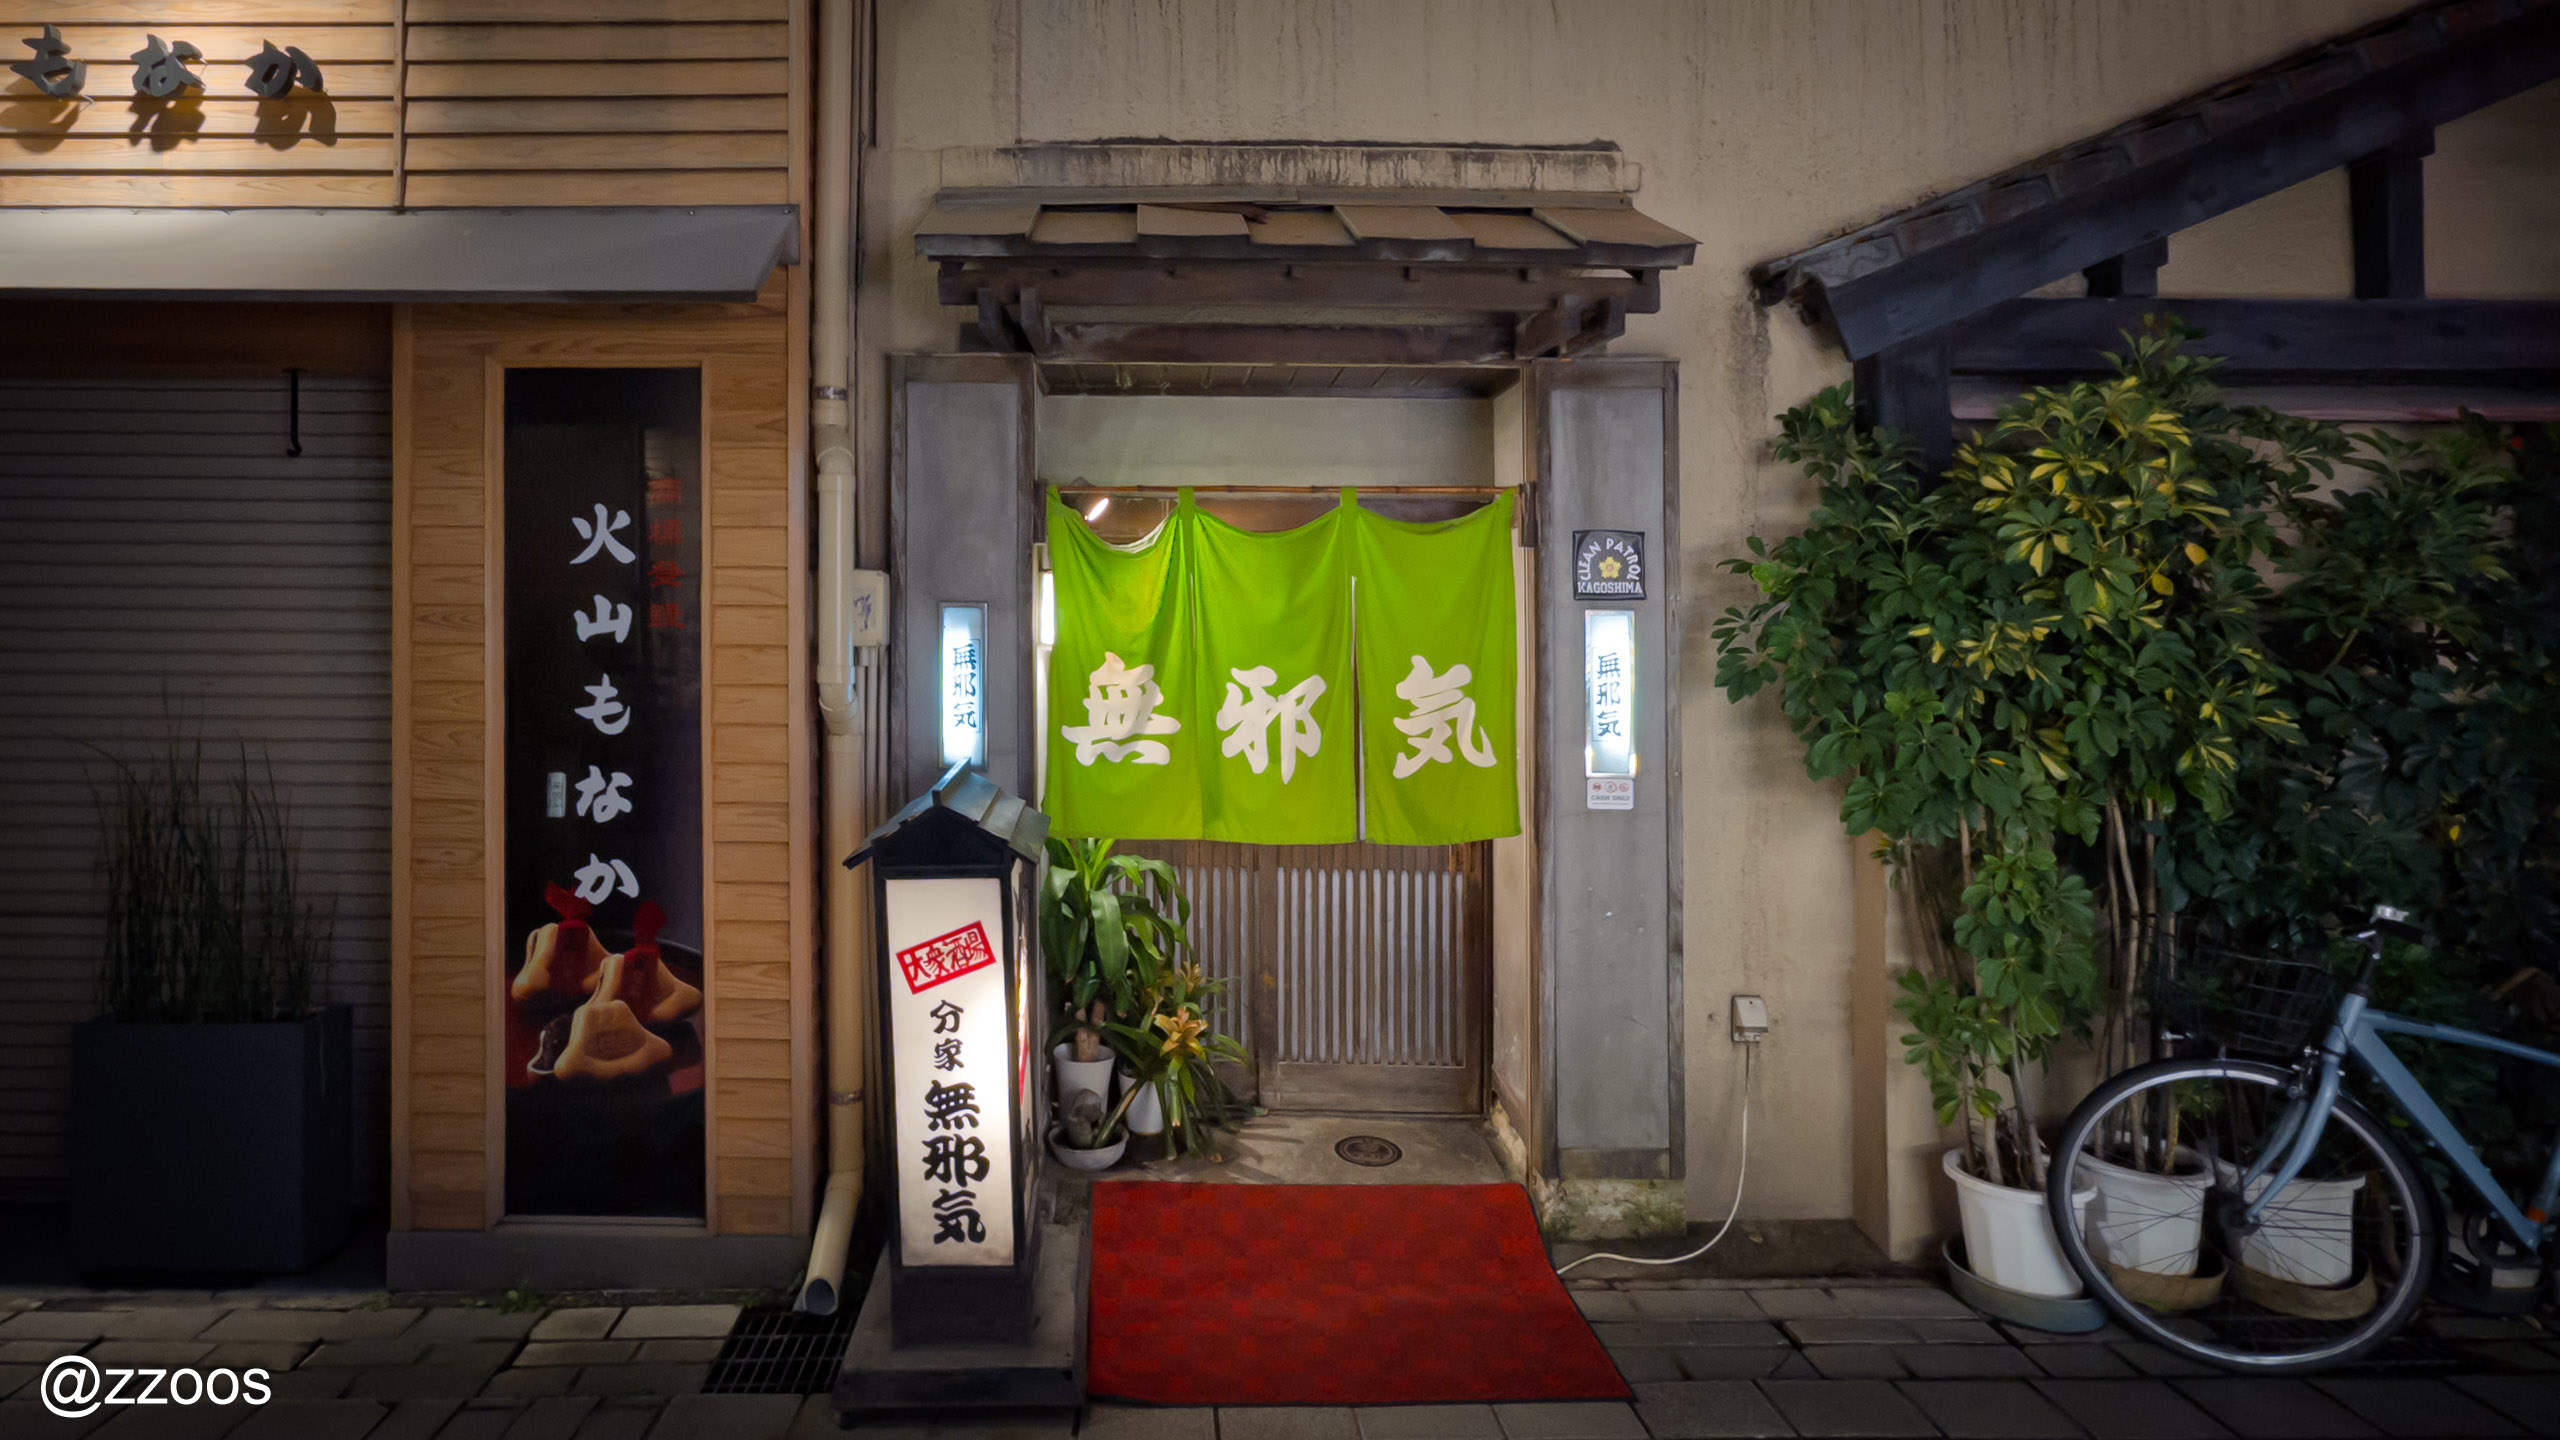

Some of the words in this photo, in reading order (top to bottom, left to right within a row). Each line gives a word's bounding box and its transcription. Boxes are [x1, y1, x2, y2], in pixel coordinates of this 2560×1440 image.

[9, 23, 325, 98] もなか
[1577, 581, 1643, 594] KAGOSHIMA
[1578, 541, 1602, 581] CLEAN
[1606, 537, 1642, 581] PATROL
[569, 503, 640, 905] 火山もなか
[952, 643, 977, 728] 無邪気
[1061, 651, 1497, 785] 無邪気
[1597, 652, 1621, 737] 無邪気
[901, 929, 989, 984] 大衆酒場
[930, 1000, 964, 1072] 分家
[922, 1080, 990, 1244] 無邪気
